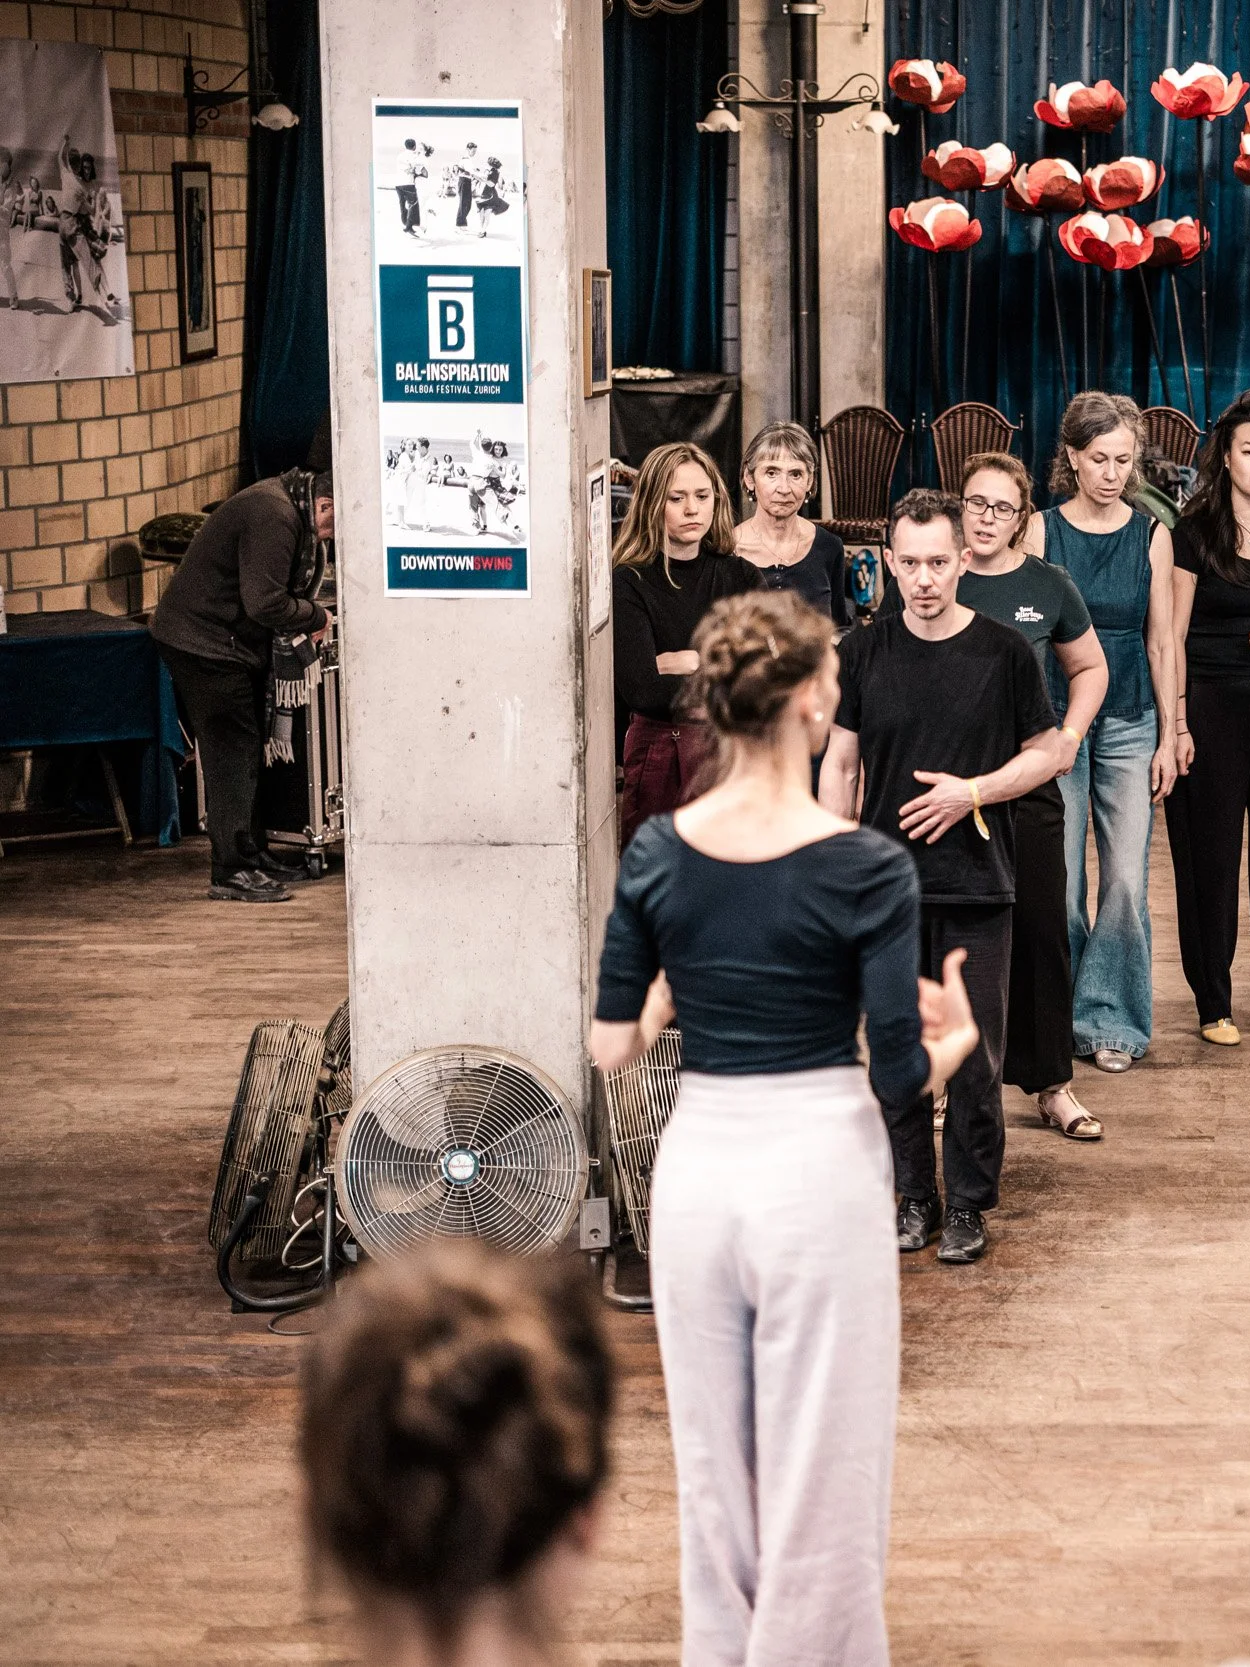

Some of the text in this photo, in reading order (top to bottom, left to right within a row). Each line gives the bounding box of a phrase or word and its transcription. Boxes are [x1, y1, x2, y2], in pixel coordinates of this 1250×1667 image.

[439, 299, 465, 352] B
[396, 363, 510, 382] BAL-INSPIRATION
[404, 384, 501, 395] BALBOA FESTIVAL ZURICH
[401, 556, 512, 570] DOWNTOWNSWING
